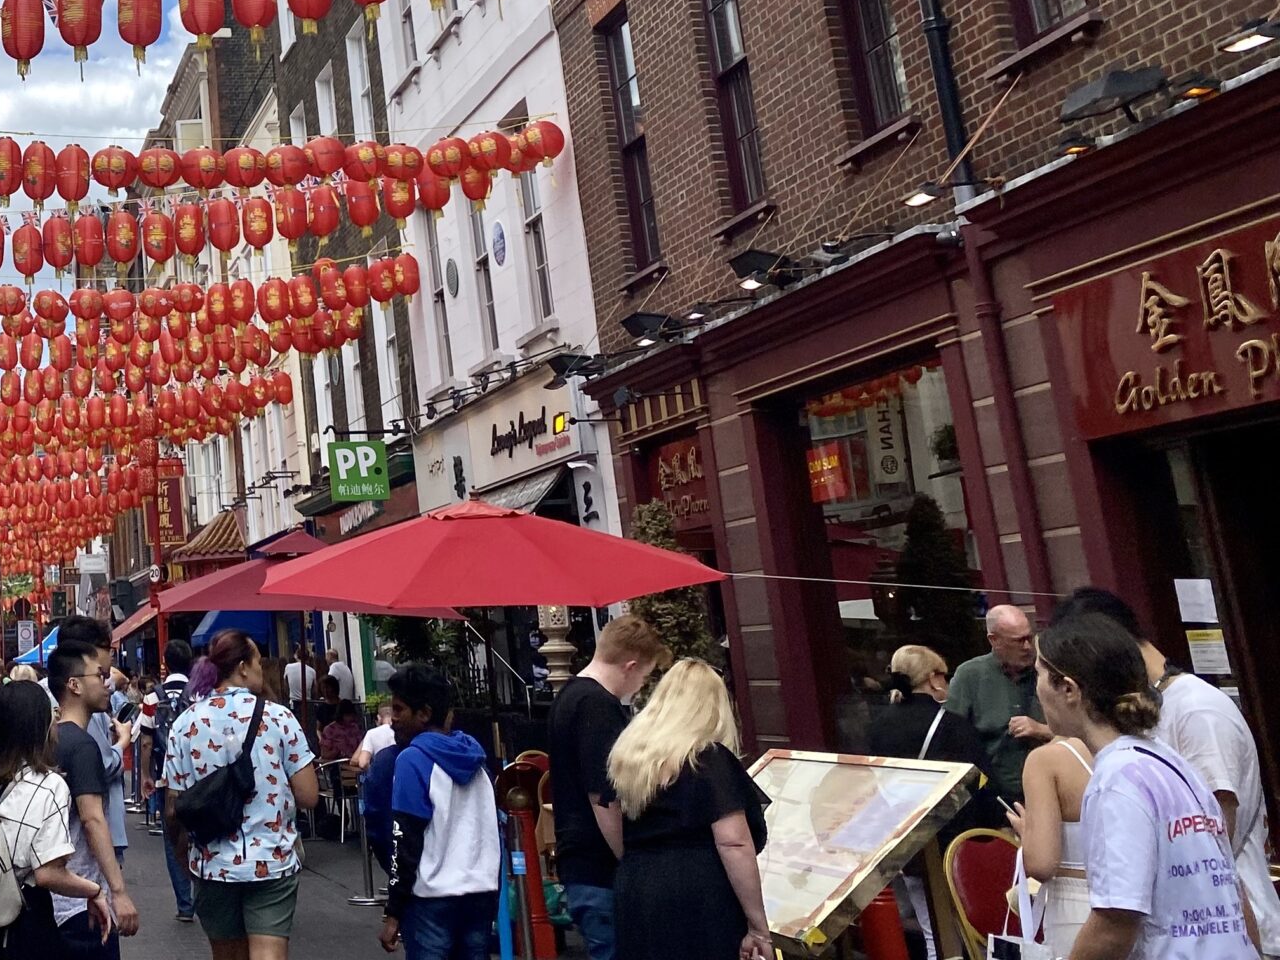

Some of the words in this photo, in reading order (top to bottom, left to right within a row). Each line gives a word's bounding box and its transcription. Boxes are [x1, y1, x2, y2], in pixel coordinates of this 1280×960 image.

[1114, 358, 1224, 416] Golden
[822, 454, 839, 470] SUM
[150, 568, 160, 578] 20
